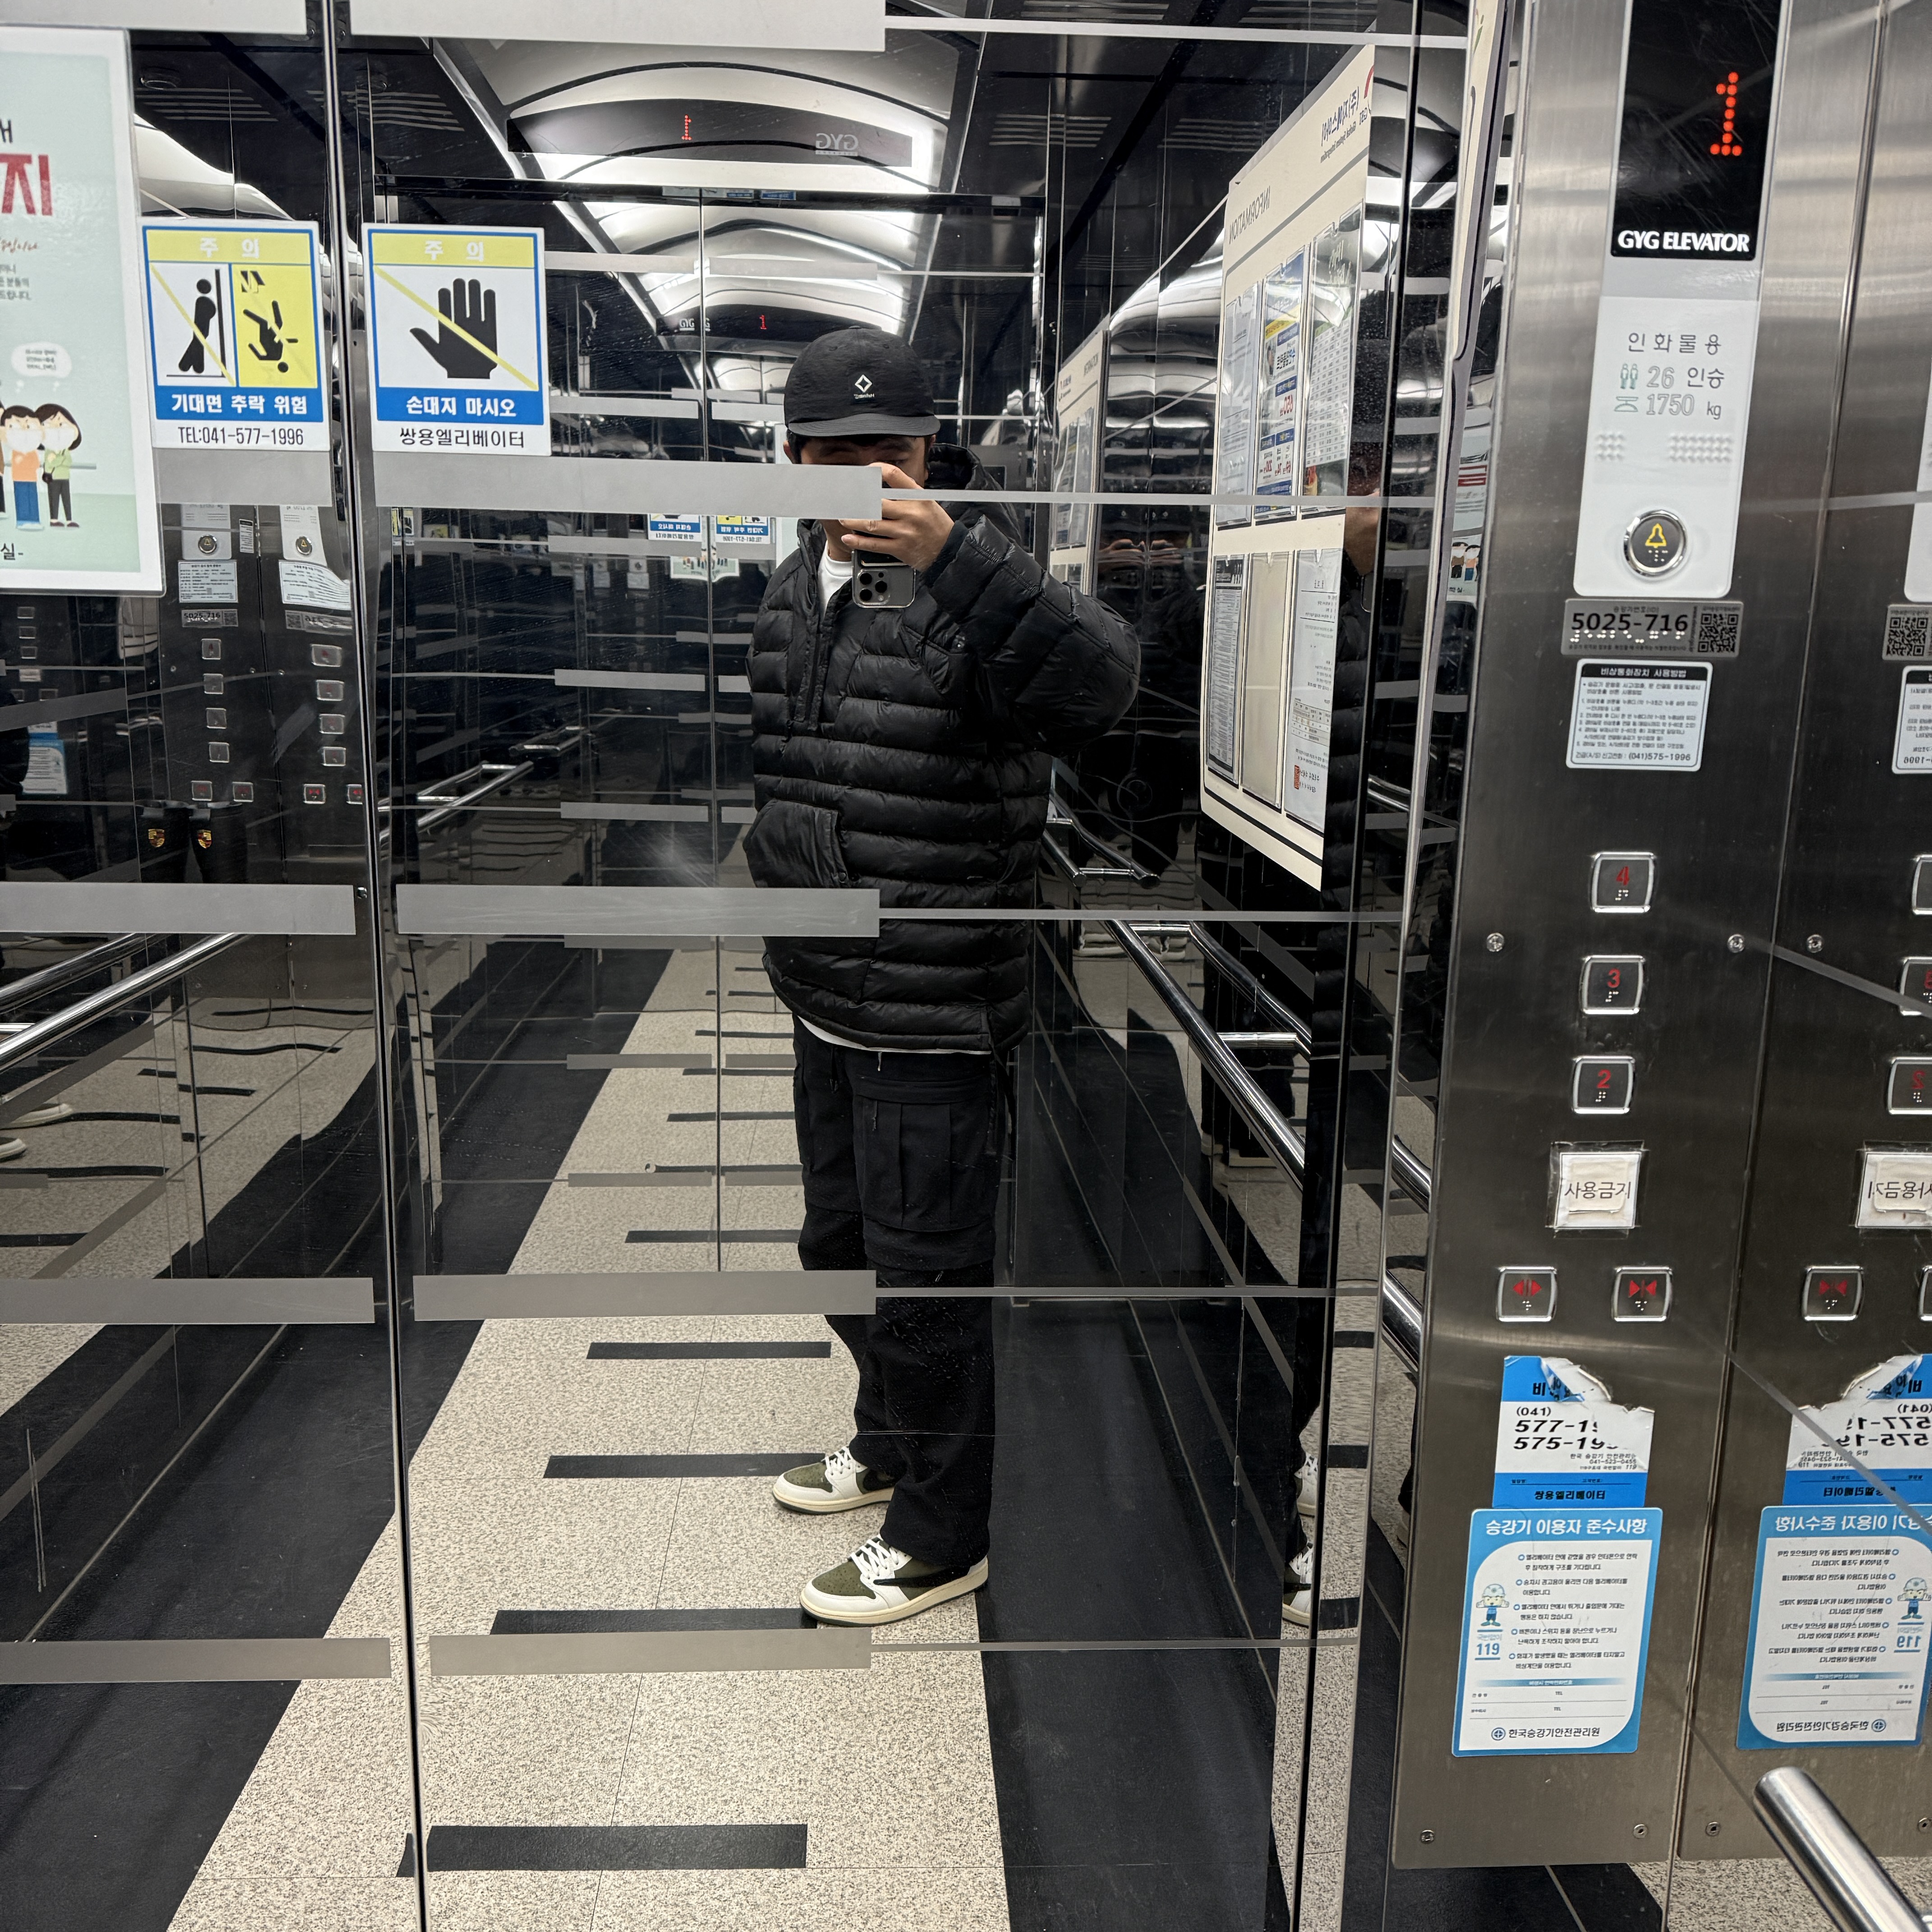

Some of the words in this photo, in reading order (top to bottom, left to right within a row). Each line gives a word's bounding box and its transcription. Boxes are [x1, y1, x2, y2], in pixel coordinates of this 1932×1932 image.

[1710, 71, 1742, 156] 1
[1618, 230, 1659, 250] GYG
[1663, 231, 1750, 253] ELEVATOR
[1646, 366, 1675, 389] 26
[1688, 367, 1725, 389] 인승
[171, 394, 222, 413] 기대면
[231, 395, 265, 414] 추락
[274, 396, 307, 414] 위험
[406, 396, 456, 415] 손대지
[466, 397, 516, 417] 마시오
[1646, 394, 1695, 416] 1750
[1707, 401, 1722, 420] kg
[178, 426, 304, 445] TEL:041-577-1996
[400, 427, 524, 448] 쌍용엘리베이터
[1571, 612, 1688, 631] 5025-716
[1601, 667, 1650, 677] 비상통화장치
[1653, 669, 1687, 678] 사용방법
[1628, 752, 1691, 761] (041)575-1996
[1615, 866, 1629, 886] 4
[1607, 968, 1621, 988] 3
[1596, 1069, 1611, 1089] 2
[1564, 1181, 1631, 1199] 사용금지
[1516, 1407, 1551, 1417] (041)
[1534, 1490, 1605, 1500] 쌍용엘리베이터
[1486, 1519, 1532, 1535] 승강기
[1536, 1519, 1580, 1535] 이용자
[1587, 1518, 1647, 1534] 준수사항
[1477, 1643, 1500, 1656] 119
[1508, 1727, 1601, 1738] 한국승강기안전관리원
